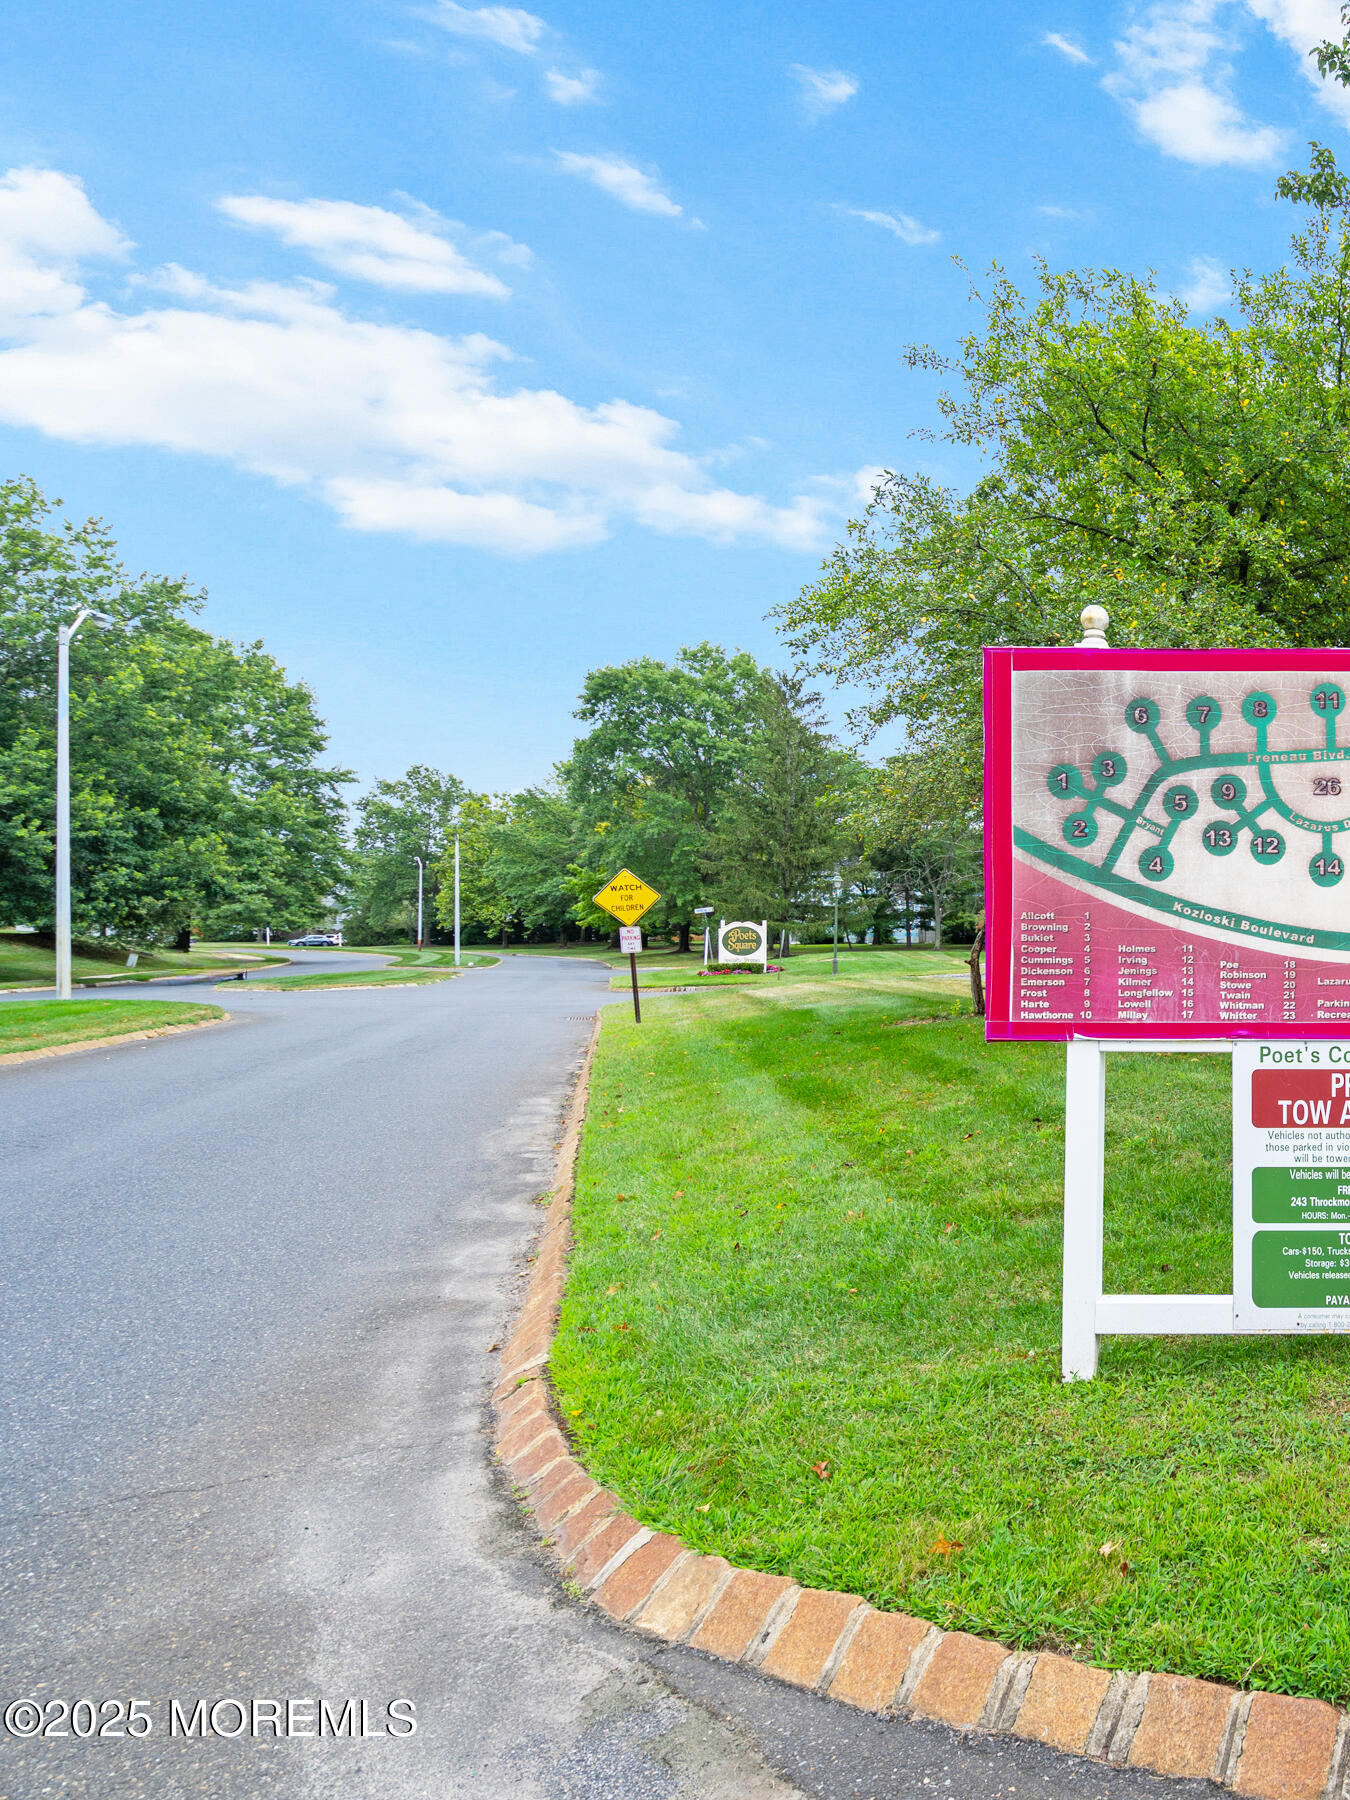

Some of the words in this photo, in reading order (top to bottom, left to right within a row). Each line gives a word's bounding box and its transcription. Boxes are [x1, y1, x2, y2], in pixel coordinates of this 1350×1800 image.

[1315, 692, 1340, 709] 11
[1198, 706, 1211, 722] 7
[1253, 701, 1268, 717] 8
[1134, 708, 1148, 724] 6
[1248, 752, 1307, 762] Freneau
[1313, 750, 1350, 761] Blvd.
[1101, 761, 1115, 777] 3
[1057, 772, 1069, 789] 1
[1222, 783, 1236, 800] 9
[1313, 778, 1341, 795] 26
[1174, 794, 1188, 810] 5
[1136, 816, 1165, 836] Bryant
[1288, 812, 1339, 832] Lazarus
[1073, 820, 1087, 837] 2
[1206, 830, 1232, 847] 13
[1253, 838, 1279, 854] 12
[1149, 857, 1162, 873] 4
[1314, 859, 1341, 876] 14
[1020, 912, 1055, 920] Allcott
[1021, 923, 1069, 933] Browning
[1173, 902, 1235, 928] Kozloski
[1240, 921, 1315, 944] Boulevard
[729, 929, 756, 942] Poets
[1021, 934, 1055, 942] Bukiet
[728, 938, 756, 952] Square
[1021, 945, 1057, 955] Cooper
[1119, 945, 1157, 953] Holmes
[1021, 956, 1074, 966] Cummings
[1119, 956, 1148, 966] Irving
[1220, 961, 1240, 969] Poe
[1021, 967, 1074, 975] Dickenson
[1118, 966, 1158, 977] Jenings
[1220, 970, 1267, 980] Robinson
[1021, 978, 1065, 987] Emerson
[1118, 978, 1152, 987] Kilmer
[1220, 981, 1252, 990] Stowe
[1021, 989, 1047, 998] Frost
[1119, 989, 1174, 999] Longfellow
[1220, 991, 1250, 1000] Twain
[1021, 1000, 1050, 1008] Harte
[1118, 1000, 1151, 1009] Lowell
[1220, 1002, 1265, 1010] Whitman
[1021, 1011, 1075, 1020] Hawthorne
[1118, 1011, 1148, 1021] Millay
[1219, 1012, 1257, 1020] Whitter
[1260, 1046, 1319, 1063] Poet's
[1278, 1100, 1331, 1125] TOW
[1268, 1131, 1304, 1139] Vehicles
[1266, 1143, 1289, 1151] those
[1293, 1143, 1322, 1153] parked
[1326, 1143, 1333, 1151] in
[1294, 1154, 1308, 1162] will
[1312, 1154, 1322, 1162] be
[1290, 1169, 1322, 1179] Vehicles
[1325, 1169, 1339, 1179] will
[1342, 1169, 1350, 1179] be
[1291, 1197, 1307, 1206] 243
[1283, 1247, 1324, 1256] Cars-$150,
